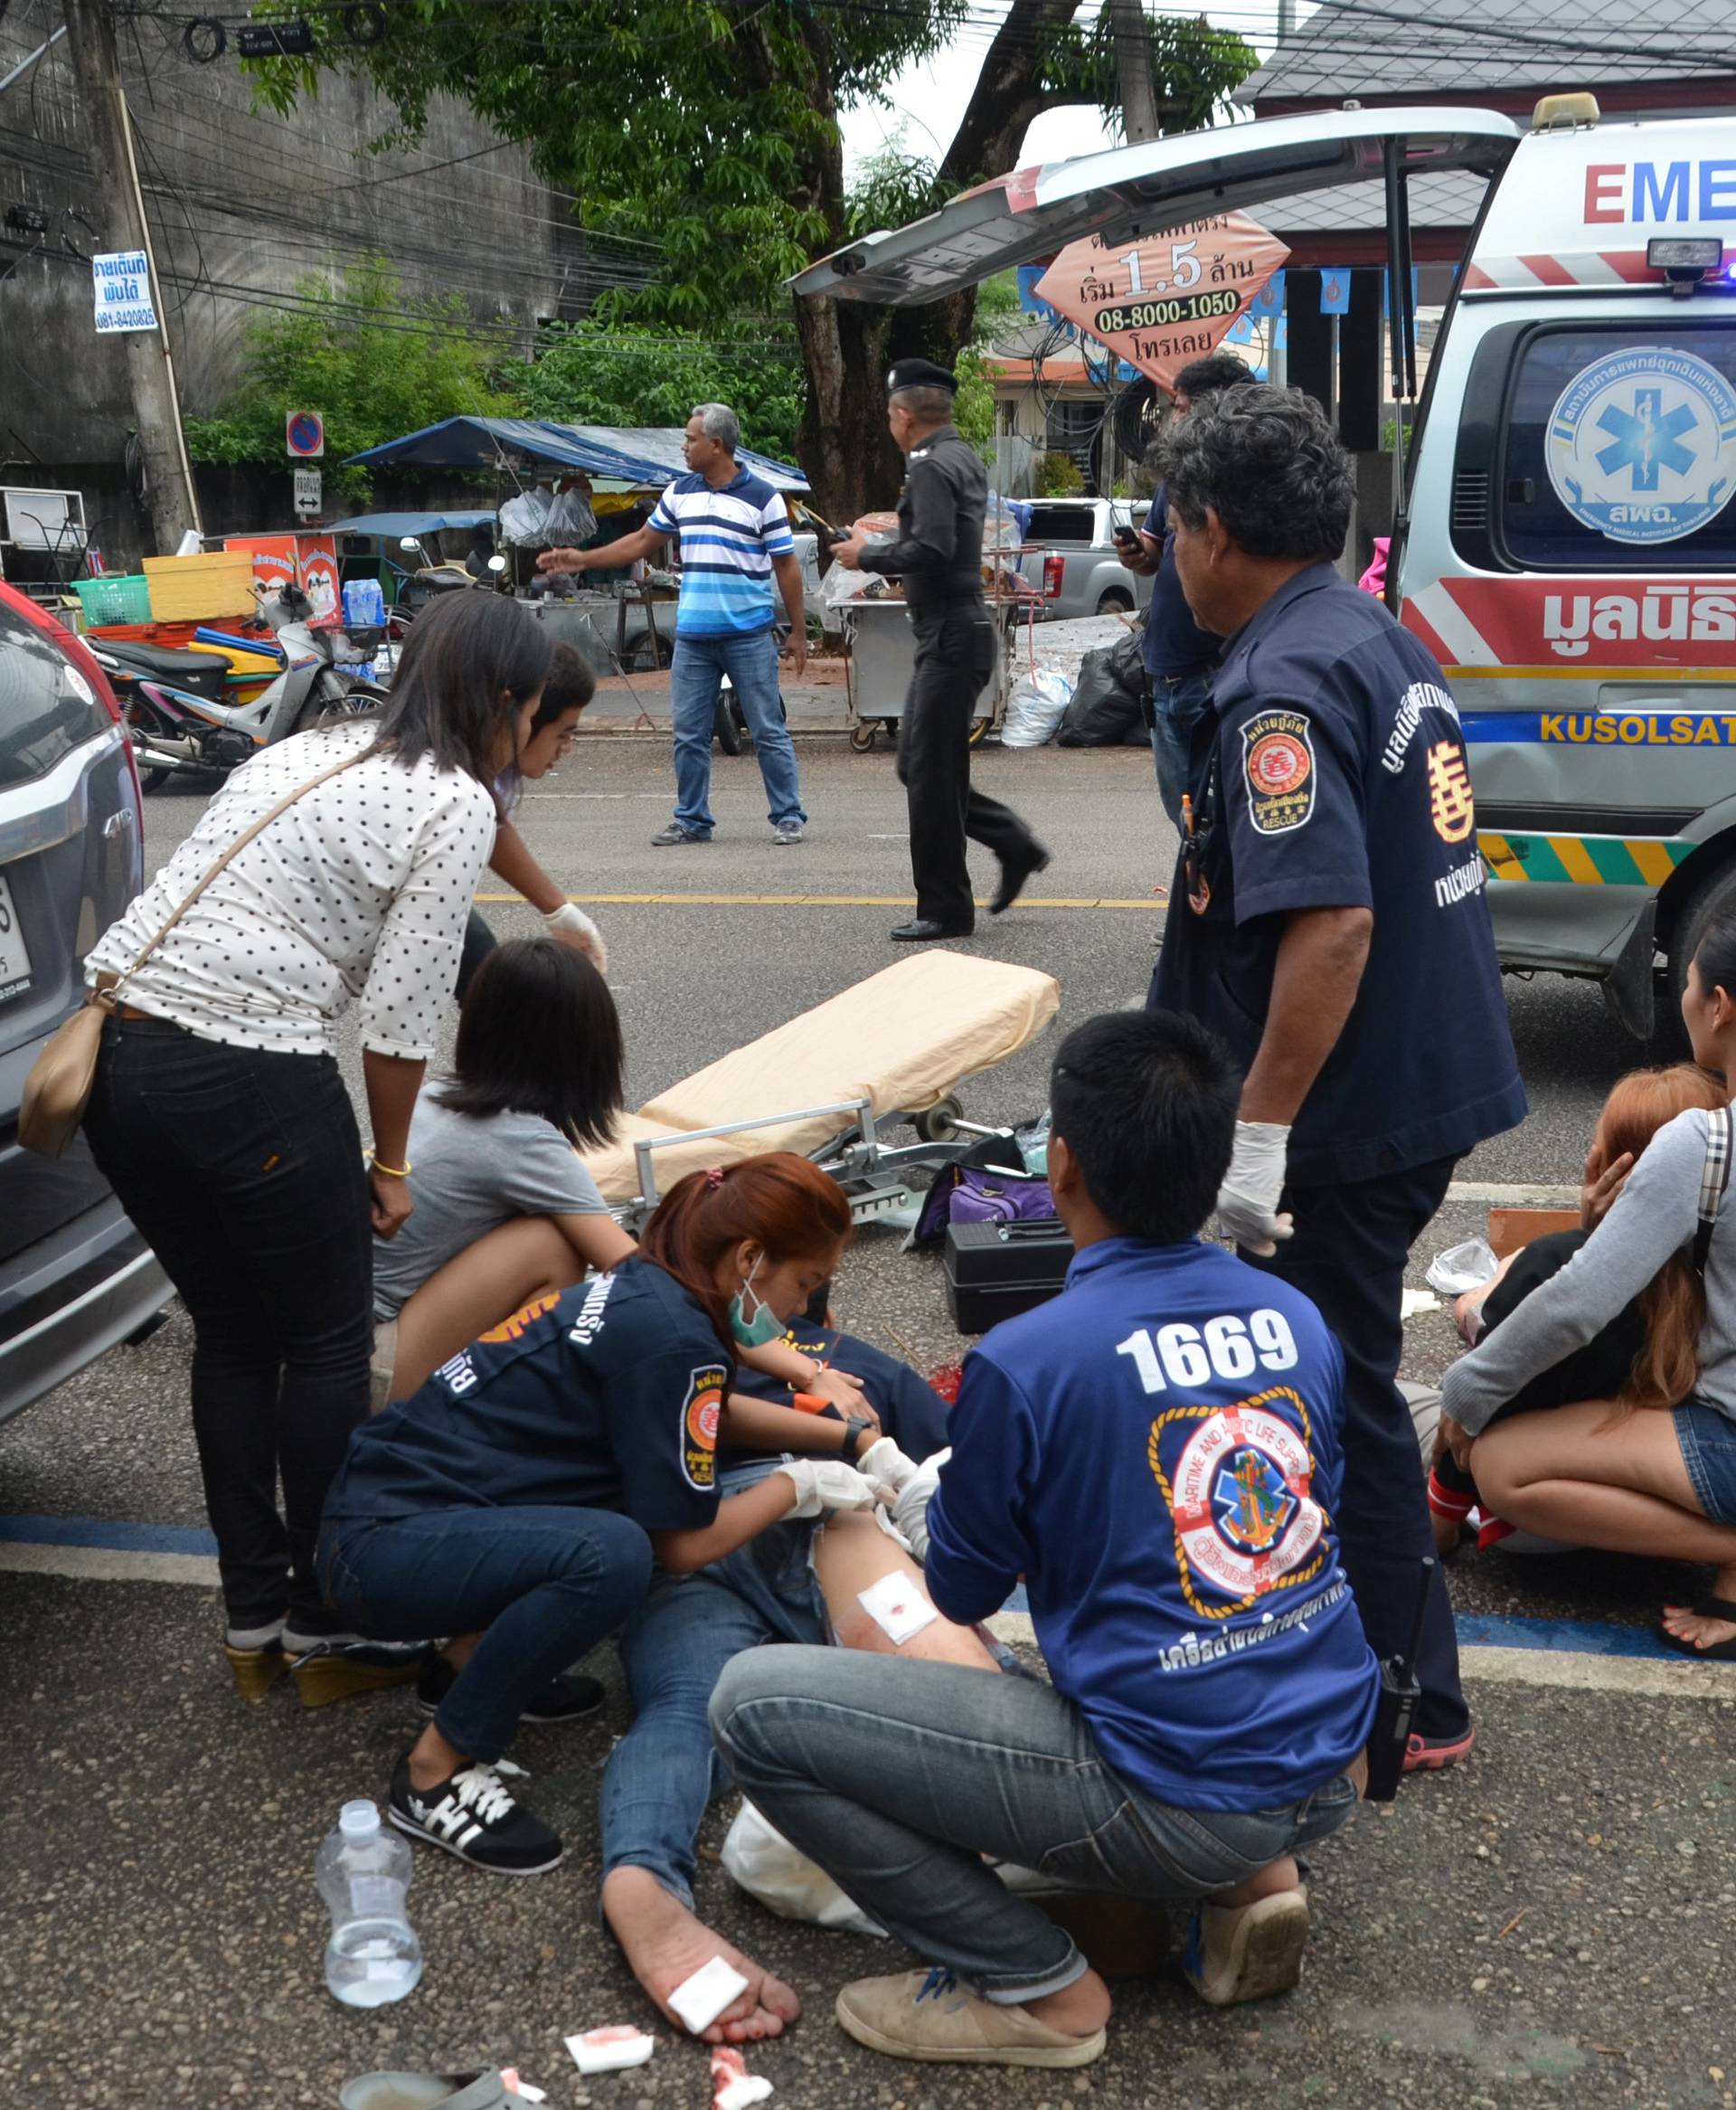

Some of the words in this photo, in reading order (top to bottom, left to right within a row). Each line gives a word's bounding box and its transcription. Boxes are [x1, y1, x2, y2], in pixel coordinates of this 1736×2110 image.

[1584, 159, 1736, 224] EME
[1080, 266, 1115, 303] เริ่ม
[1118, 239, 1203, 298] 1.5
[1210, 254, 1255, 283] ล้าน
[96, 308, 156, 328] 081-8420825
[1098, 291, 1237, 334] 08-8000-1050
[1128, 332, 1212, 362] โทรเลย
[1609, 506, 1678, 523] สพฉ.
[1262, 813, 1298, 829] RESCUE
[1115, 1309, 1299, 1395] 1669
[1184, 1452, 1207, 1519] MARITIME
[1201, 1427, 1222, 1457] AND
[1255, 1421, 1278, 1444] LIFE
